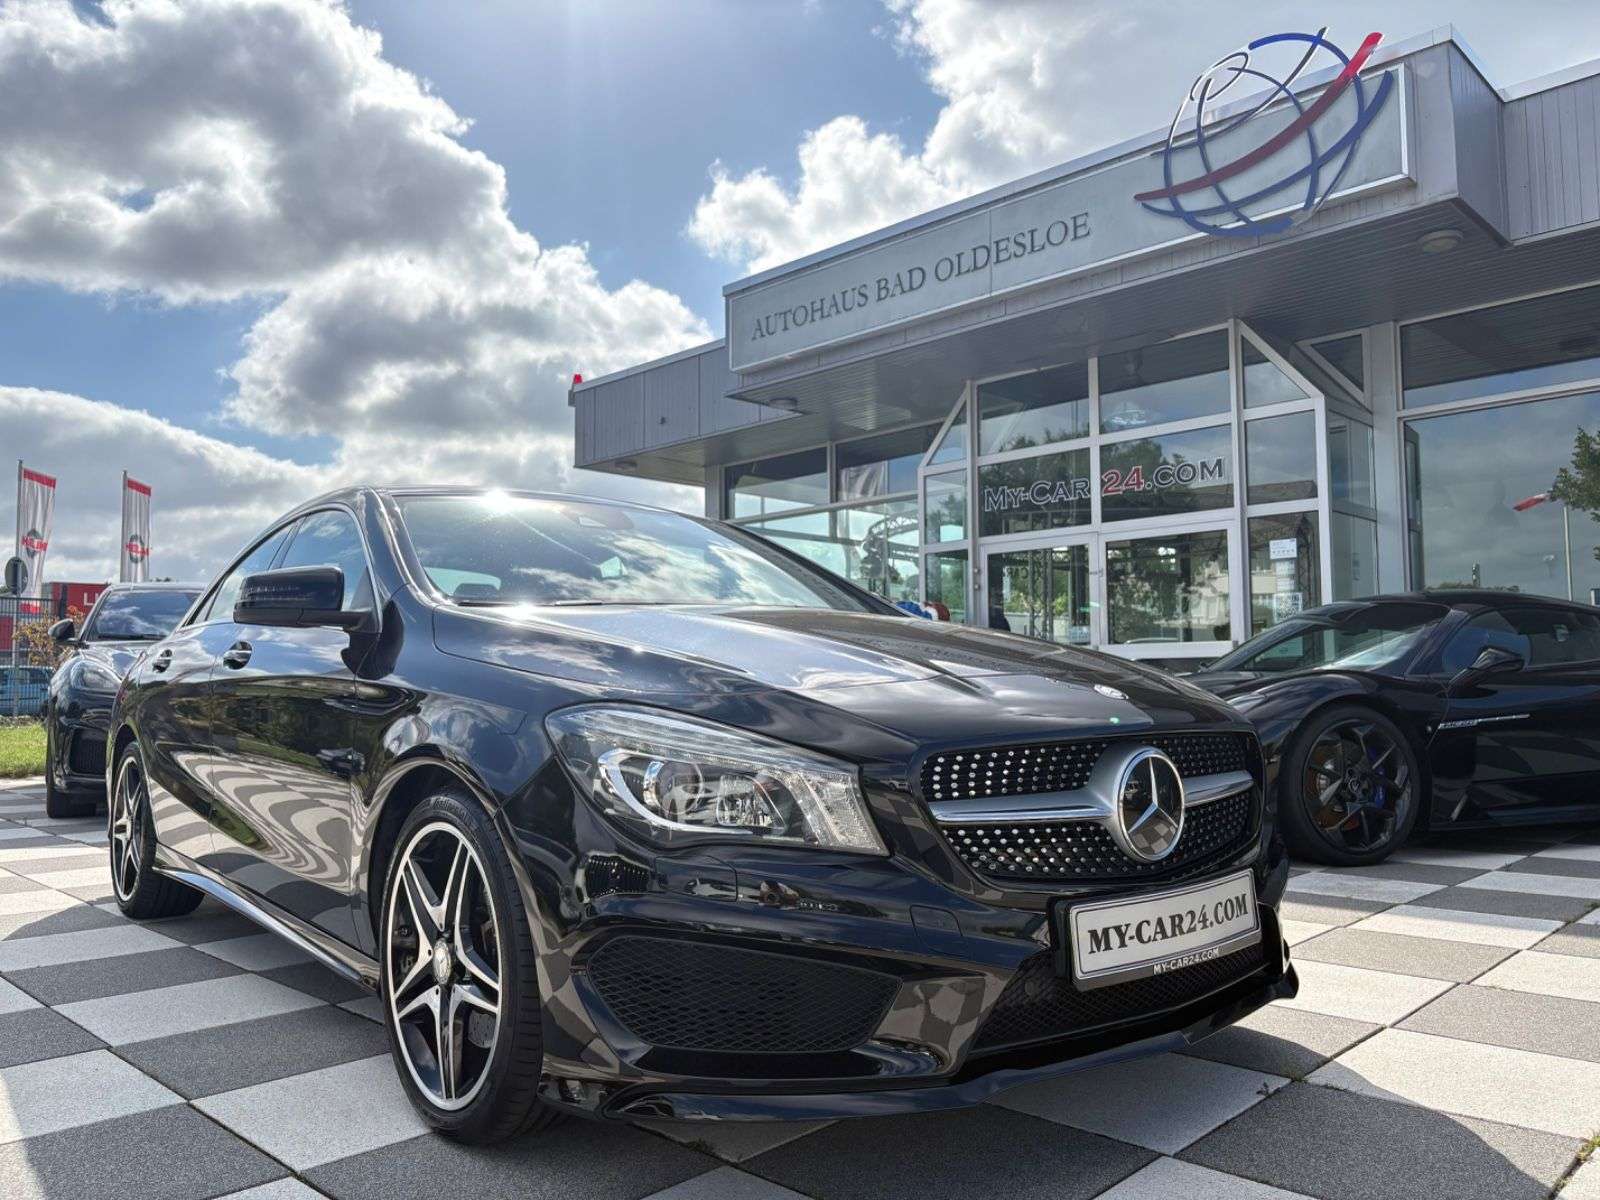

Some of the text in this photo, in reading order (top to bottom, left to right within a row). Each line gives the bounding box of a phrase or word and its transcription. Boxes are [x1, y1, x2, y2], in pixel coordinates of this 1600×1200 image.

[751, 212, 1091, 341] AUTOHAUS BAD OLDESLOE
[1087, 893, 1249, 955] MY-CAR24.COM
[1153, 947, 1219, 975] MY-CAR24.COM
